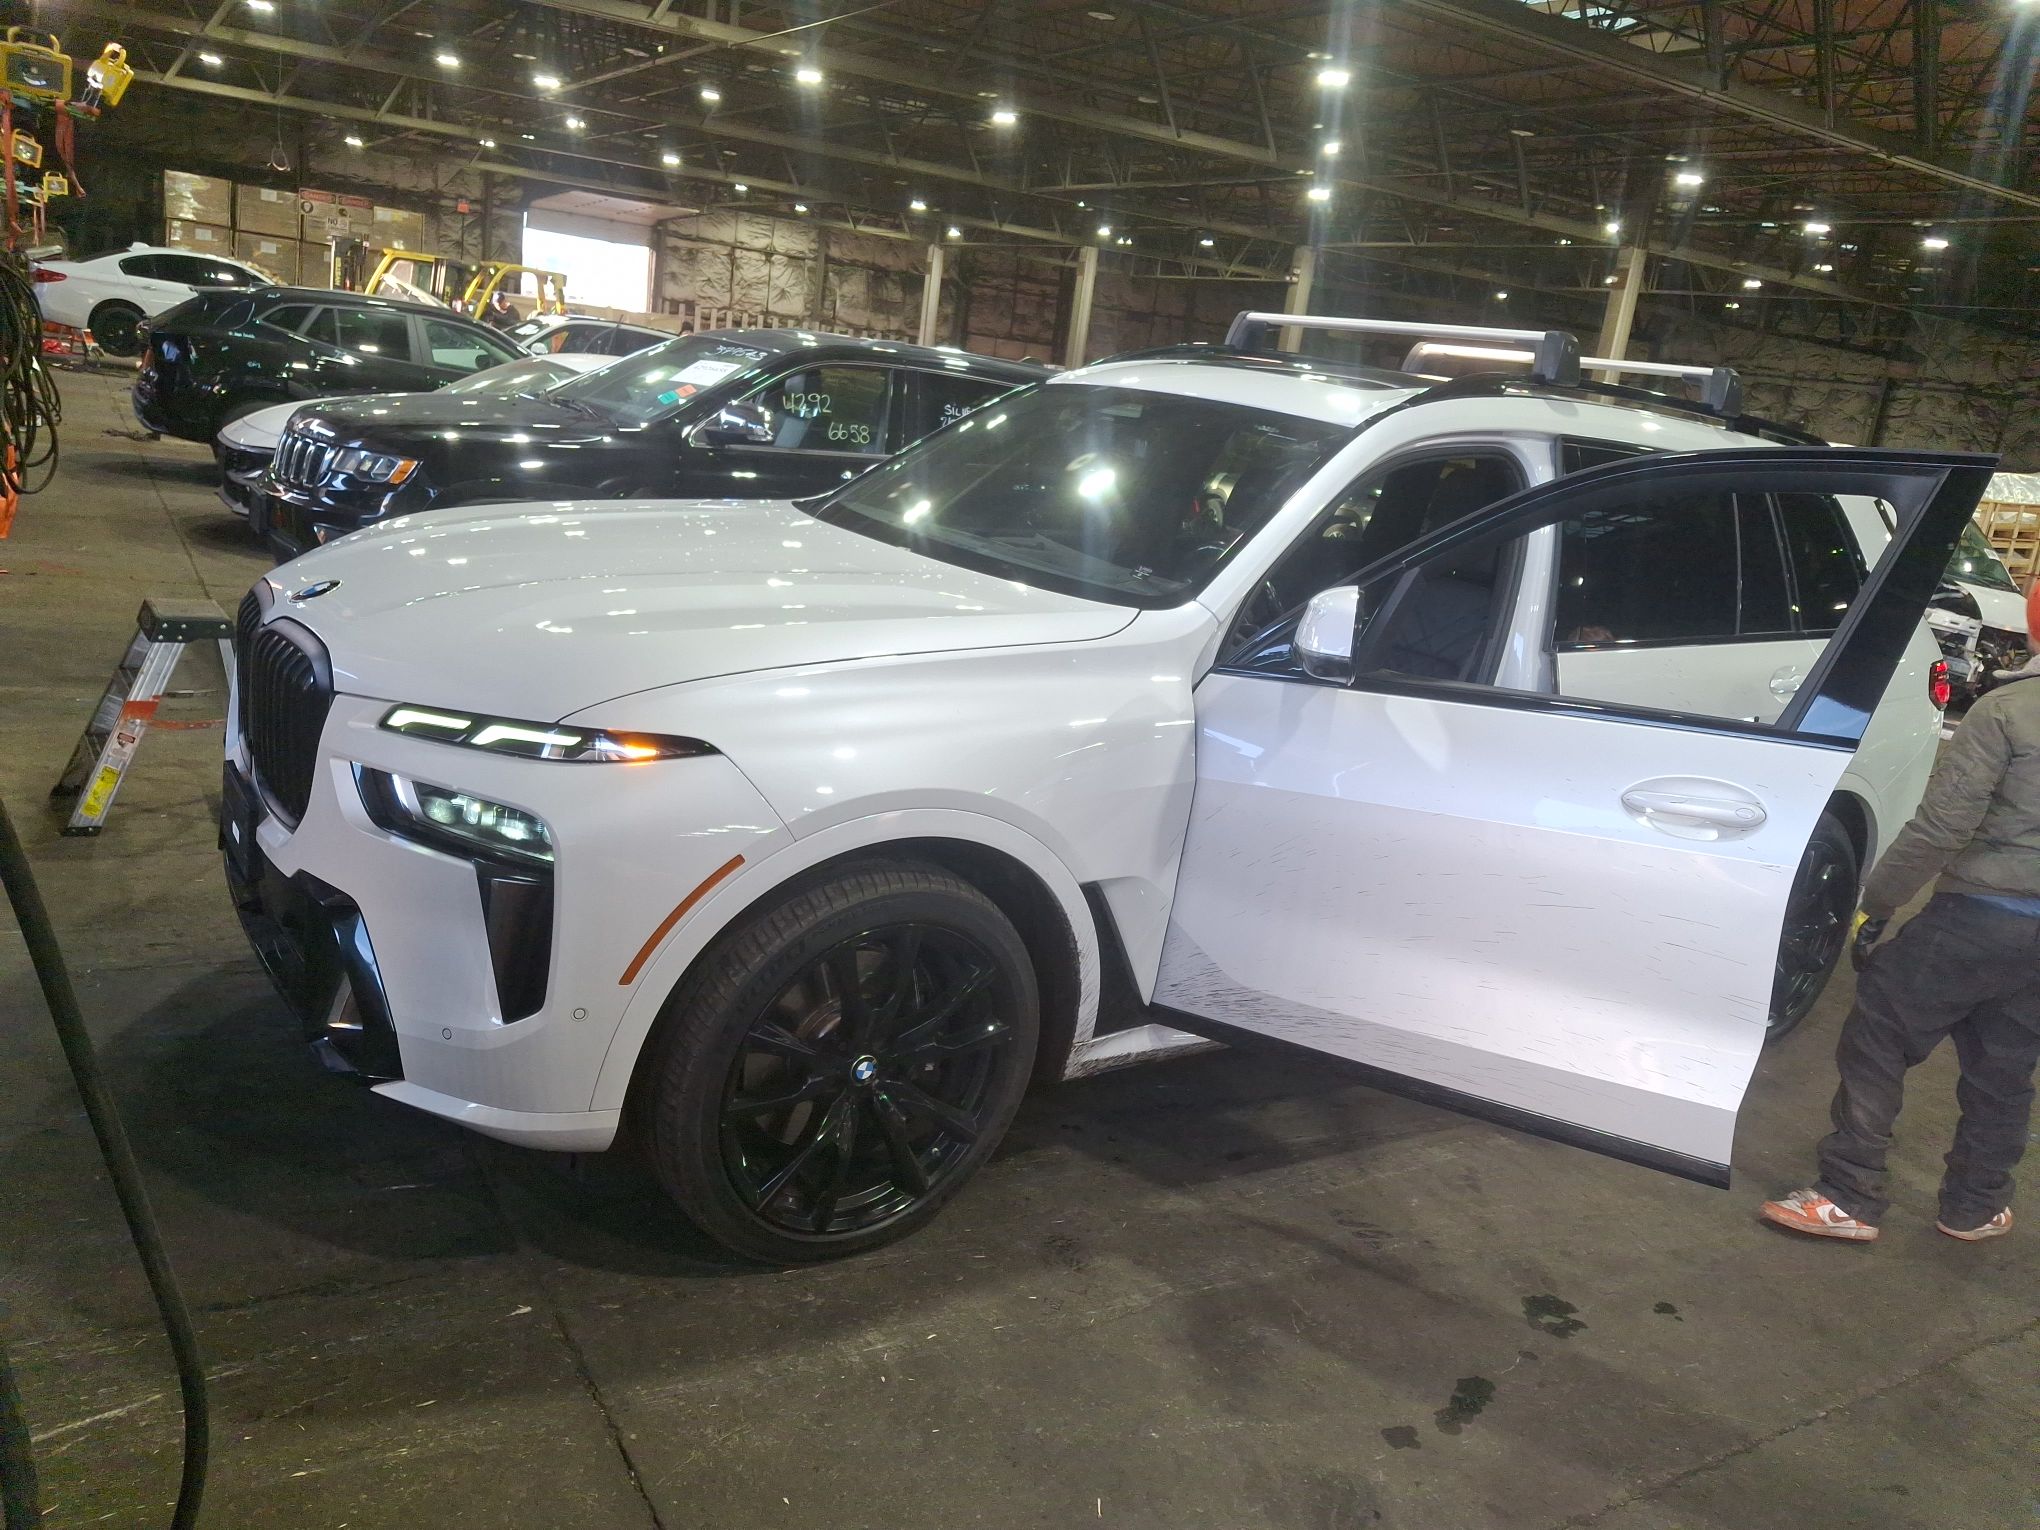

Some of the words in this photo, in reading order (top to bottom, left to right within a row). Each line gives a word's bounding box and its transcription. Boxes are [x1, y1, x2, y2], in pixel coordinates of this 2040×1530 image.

[782, 392, 832, 414] 4292
[944, 404, 972, 416] SILVE
[828, 421, 870, 444] 6658
